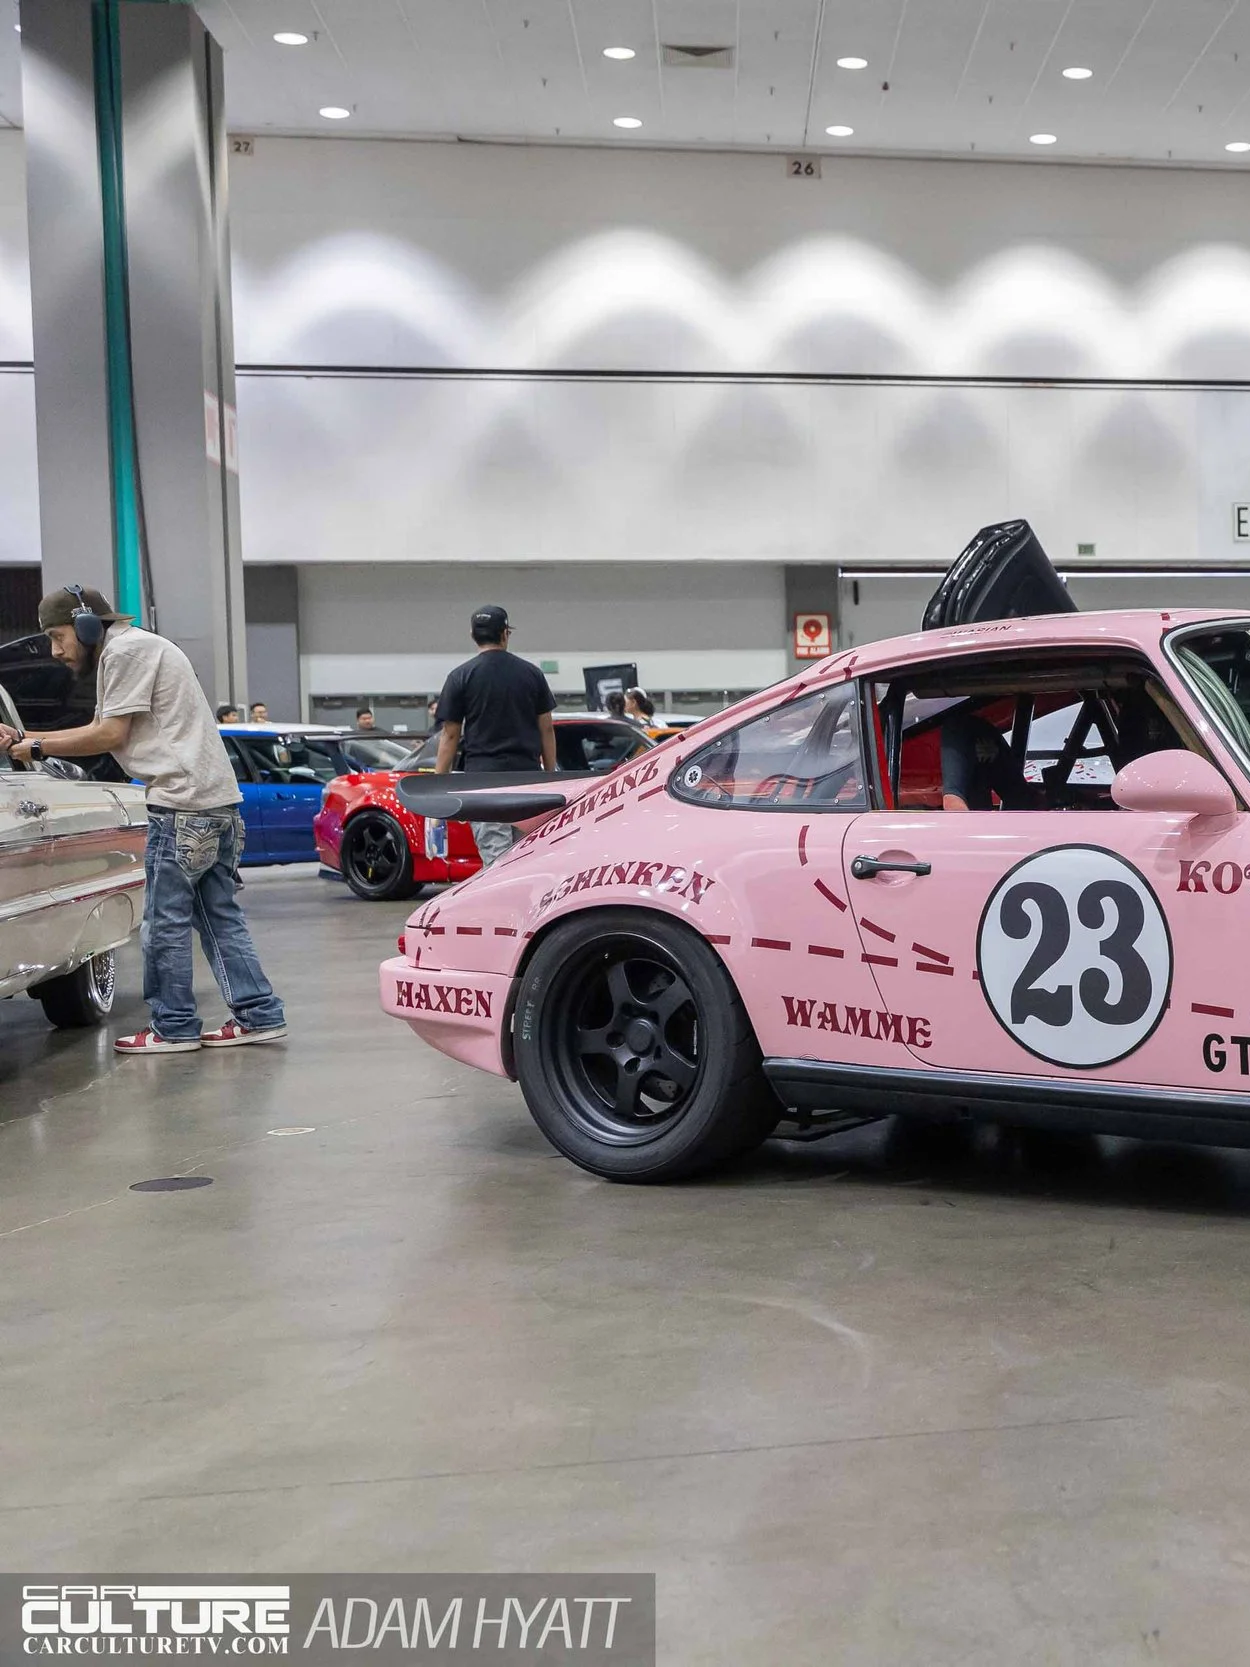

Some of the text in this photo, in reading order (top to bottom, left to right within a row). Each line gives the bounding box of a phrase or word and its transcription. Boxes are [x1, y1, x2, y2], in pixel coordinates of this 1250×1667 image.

[233, 141, 250, 152] 27
[792, 160, 814, 175] 26
[519, 756, 661, 850] SCHWANZ
[538, 861, 716, 917] SCHINKEN
[999, 879, 1153, 1027] 23
[396, 979, 493, 1019] HAXEN
[781, 995, 933, 1049] WAMME
